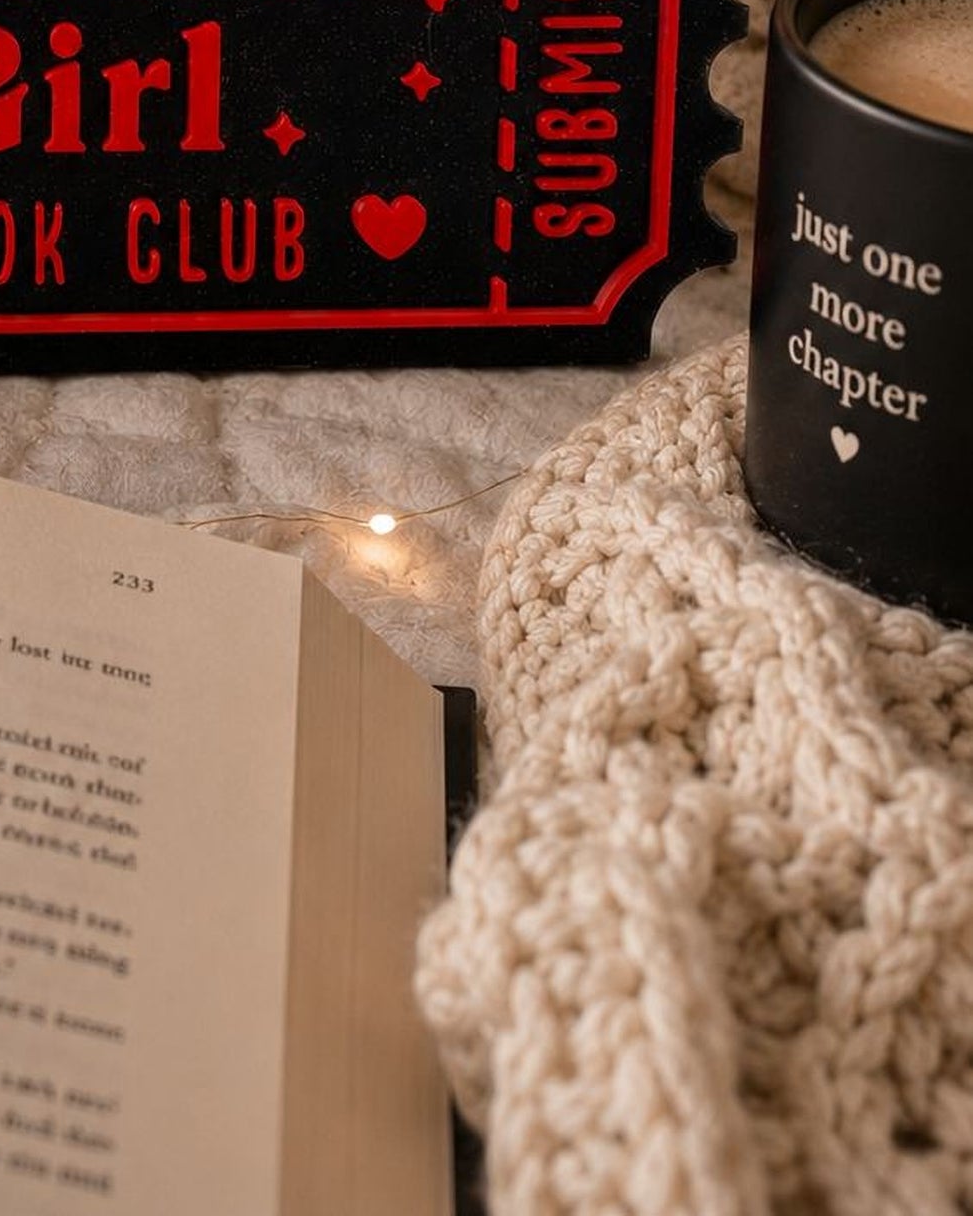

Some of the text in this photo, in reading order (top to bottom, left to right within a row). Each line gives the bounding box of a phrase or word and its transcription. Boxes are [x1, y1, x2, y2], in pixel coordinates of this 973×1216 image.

[127, 196, 305, 285] CLUB
[791, 191, 943, 296] just one
[810, 281, 906, 351] more
[788, 327, 928, 422] chapter
[111, 570, 156, 594] 233
[11, 635, 50, 662] lost
